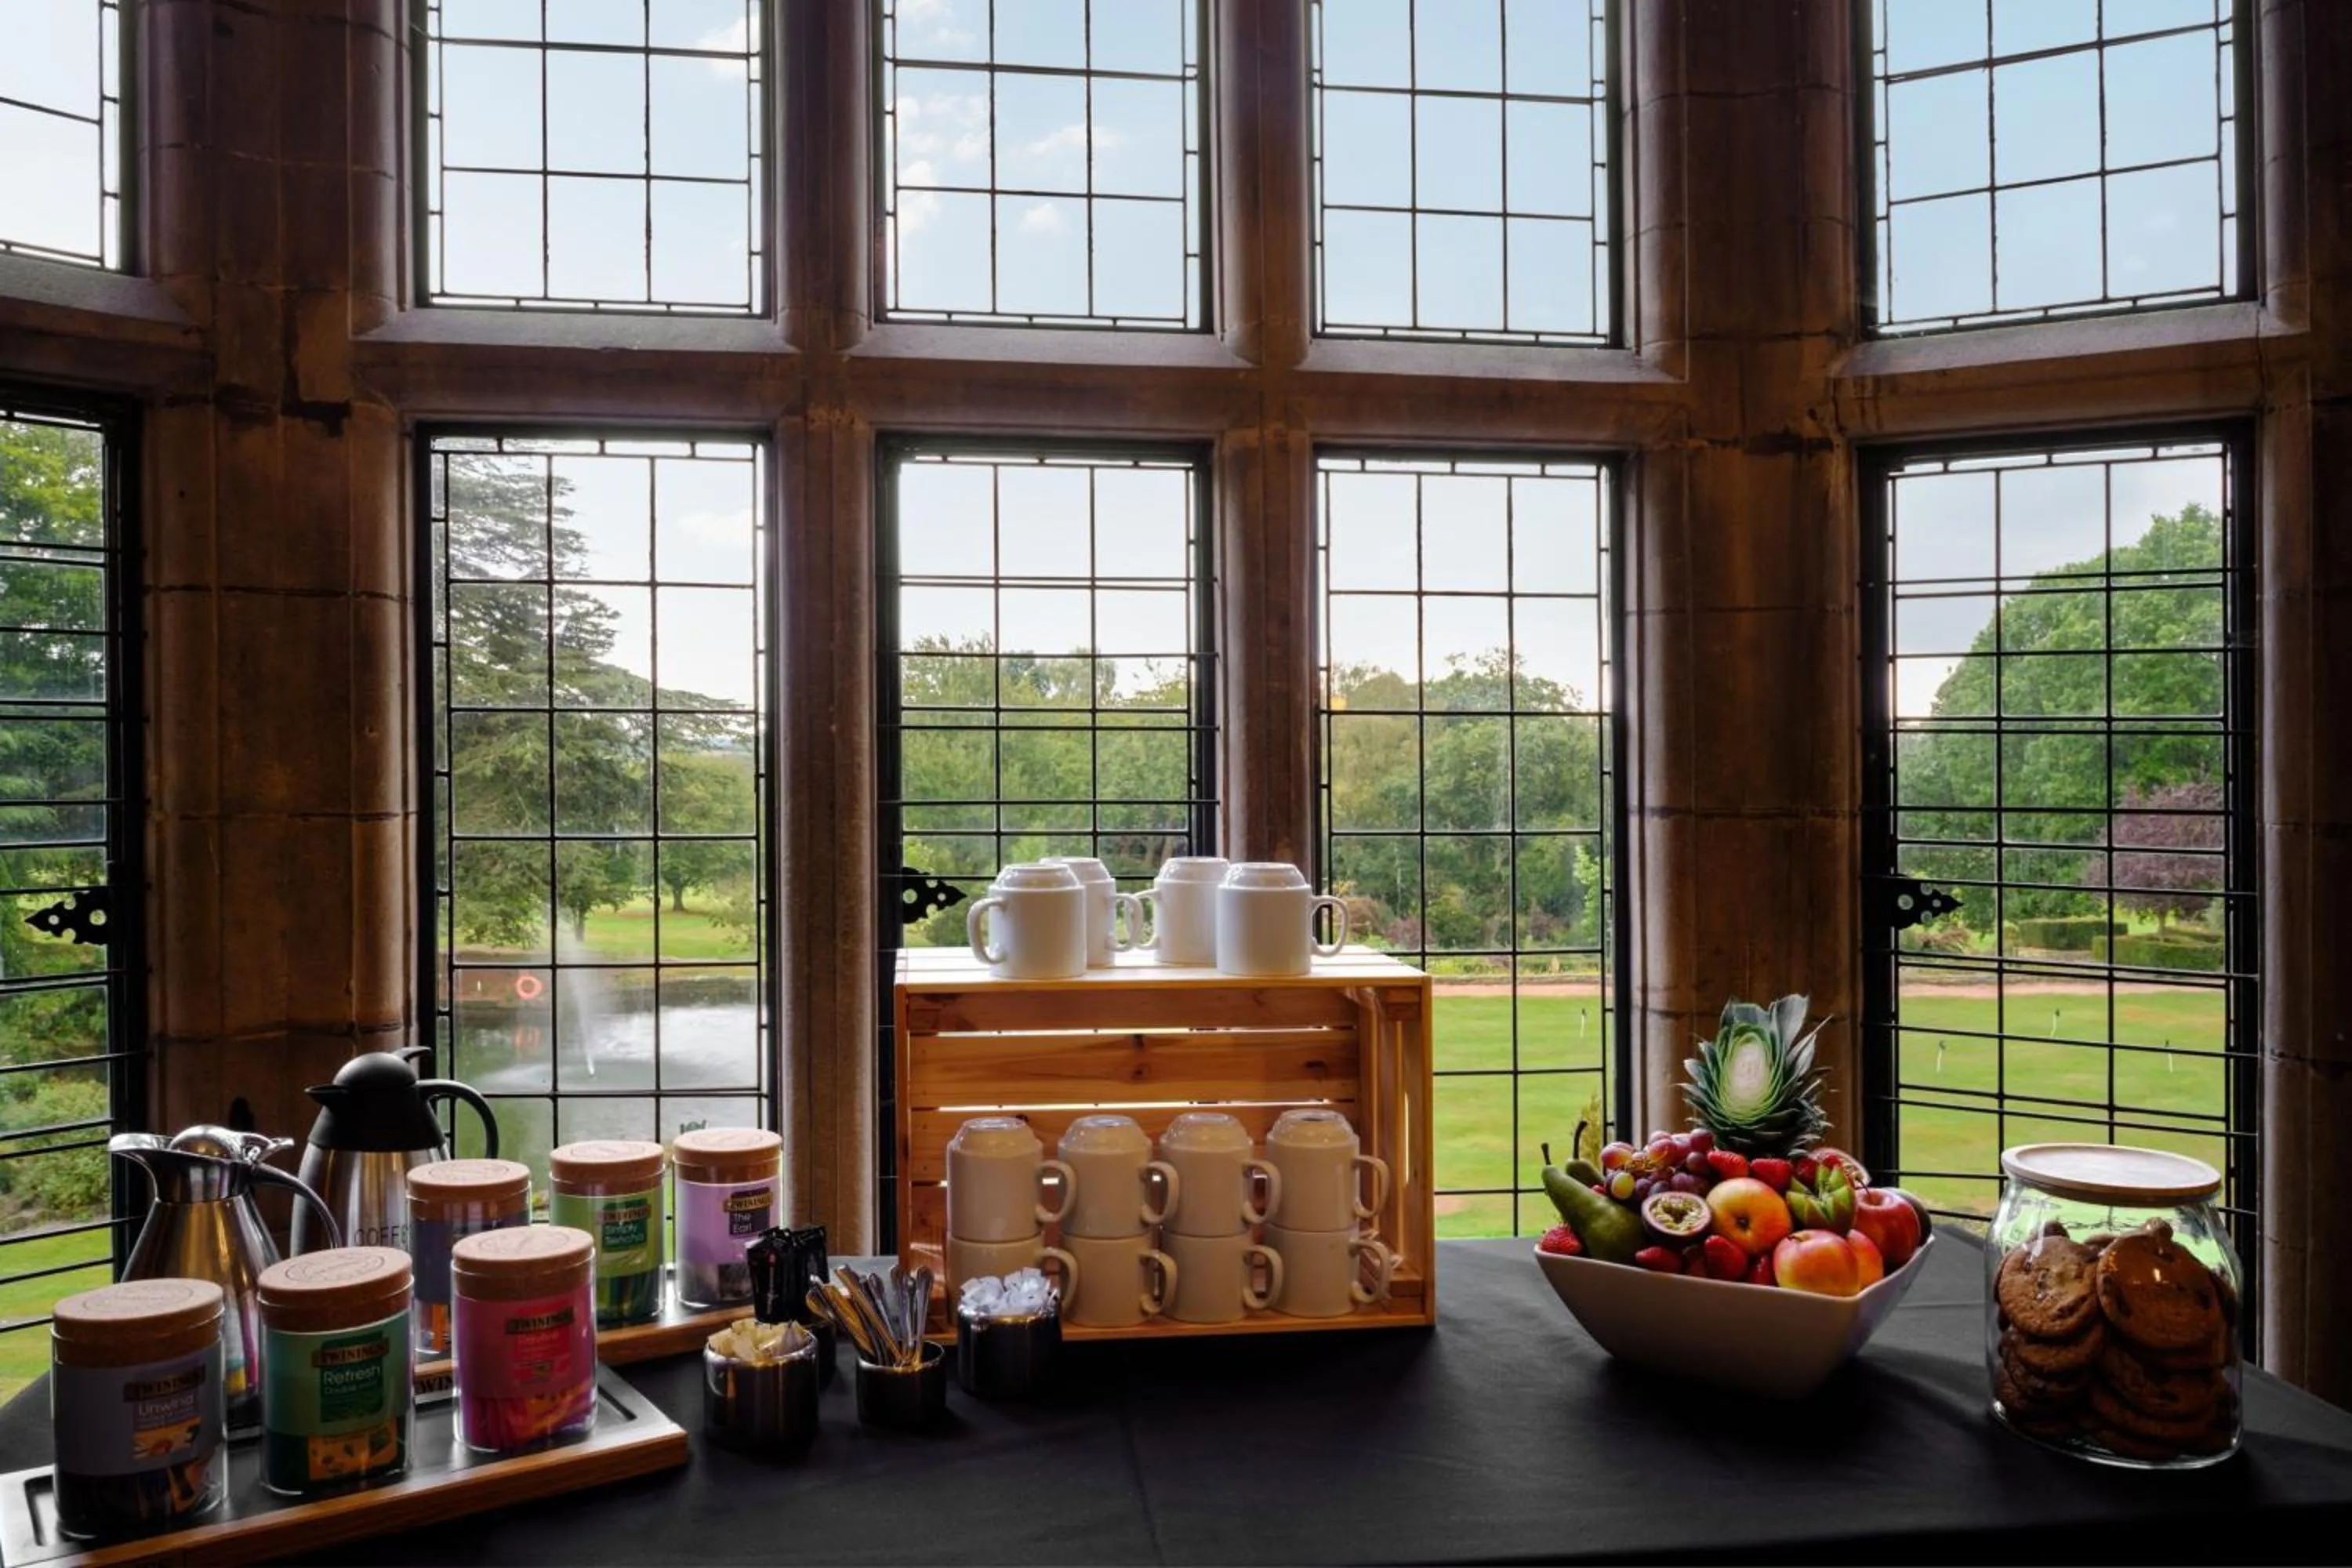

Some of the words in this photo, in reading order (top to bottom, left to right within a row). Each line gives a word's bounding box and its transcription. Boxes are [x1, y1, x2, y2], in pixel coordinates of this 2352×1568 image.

[733, 1222, 752, 1233] Earl
[734, 1213, 751, 1222] The
[354, 1224, 409, 1247] COFFE
[321, 1341, 387, 1364] TWININGS
[323, 1366, 381, 1385] Refresh
[138, 1392, 194, 1417] Unwind
